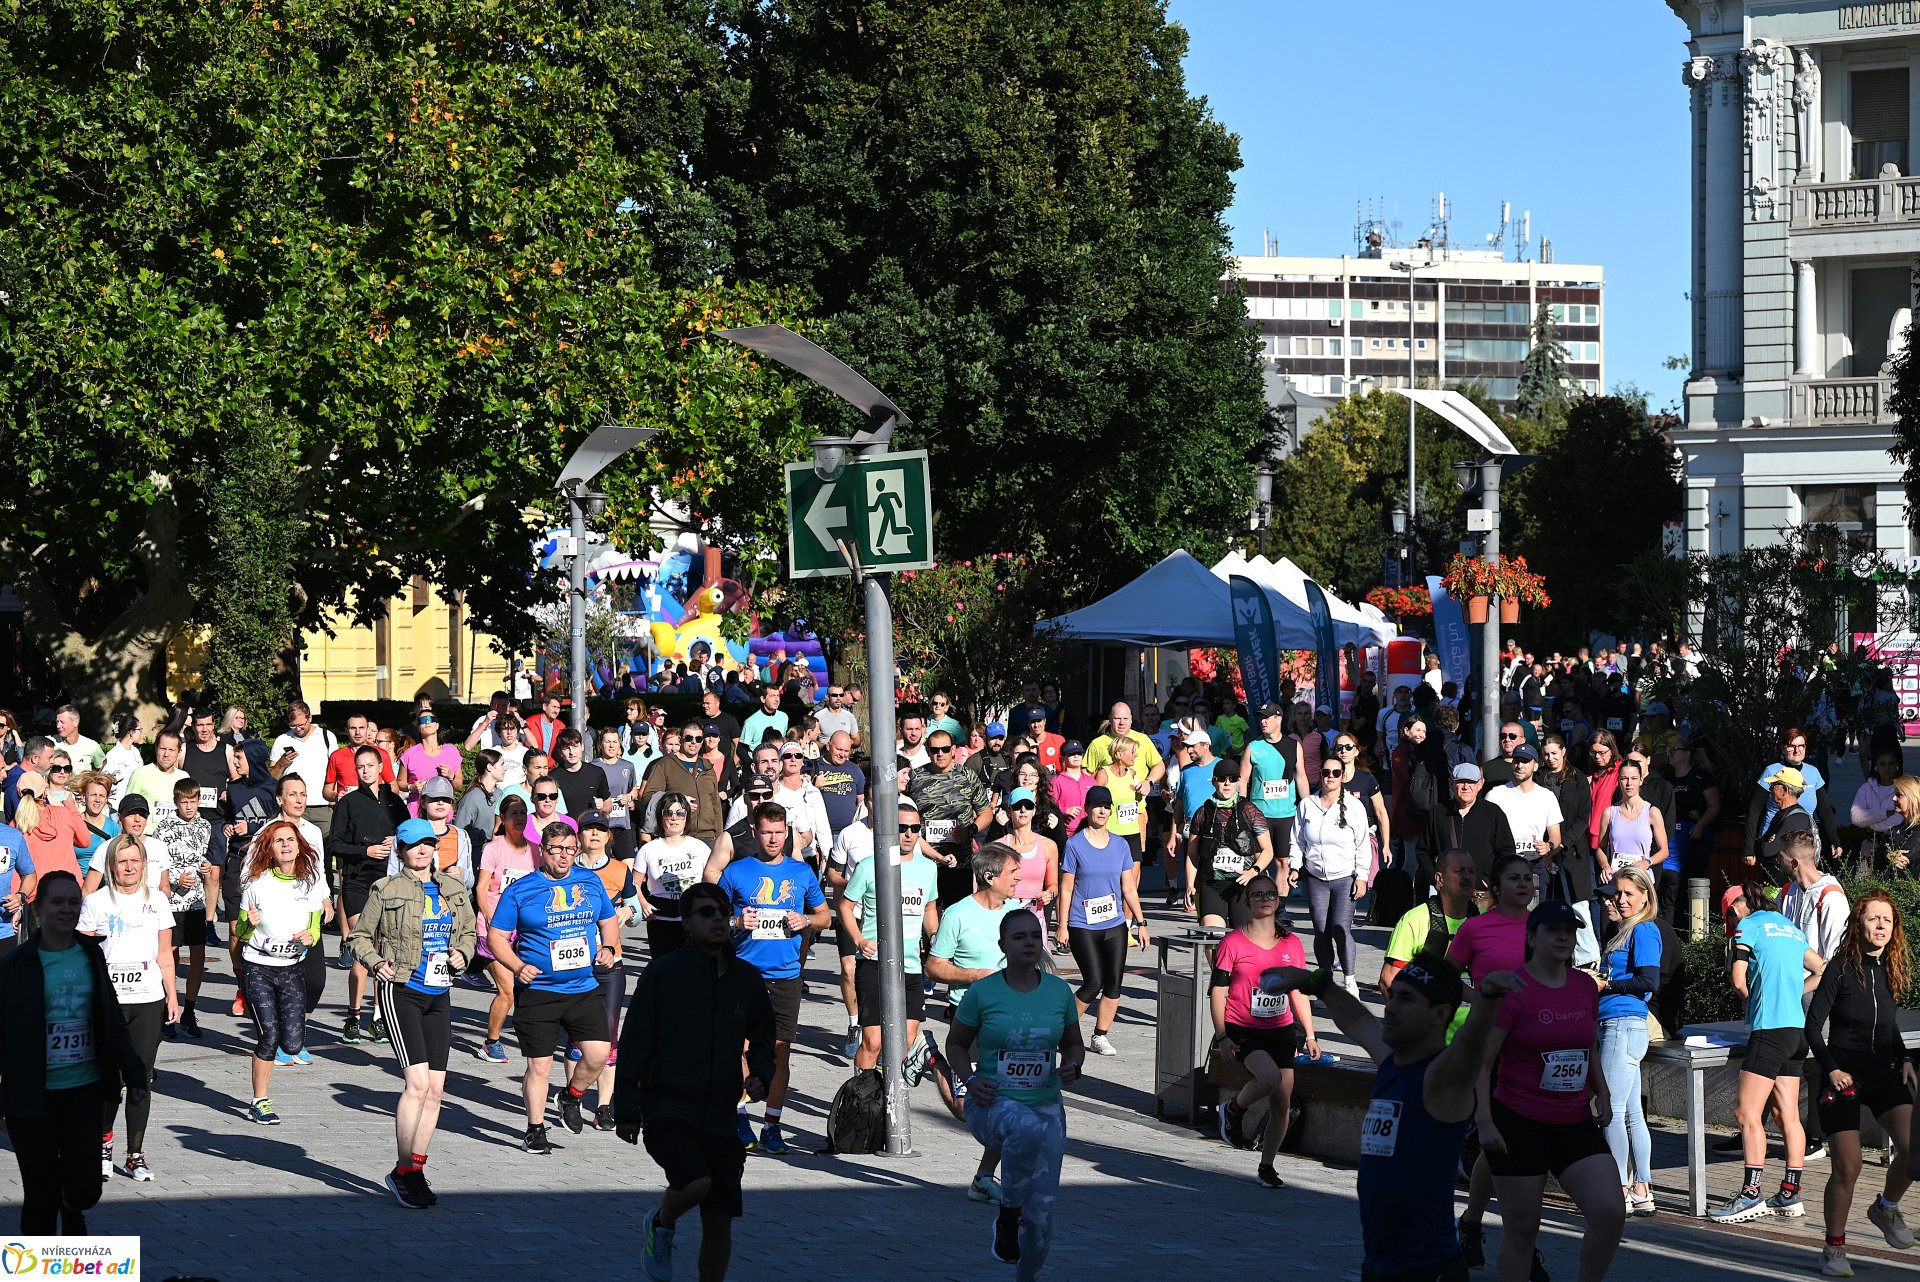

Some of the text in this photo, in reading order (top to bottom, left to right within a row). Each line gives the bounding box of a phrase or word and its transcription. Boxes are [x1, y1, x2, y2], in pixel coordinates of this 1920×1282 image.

[1265, 786, 1288, 794] 21169
[1119, 808, 1139, 818] 21124
[1215, 856, 1243, 864] 21142
[662, 860, 692, 873] 21202
[1091, 903, 1113, 915] 5083
[547, 910, 594, 924] SISTER CITY
[270, 944, 299, 953] 5155
[558, 947, 584, 960] 5036
[111, 972, 142, 983] 5102
[1257, 996, 1285, 1007] 10091
[51, 1032, 92, 1049] 21313
[1006, 1063, 1043, 1076] 5070
[1552, 1064, 1583, 1078] 2564
